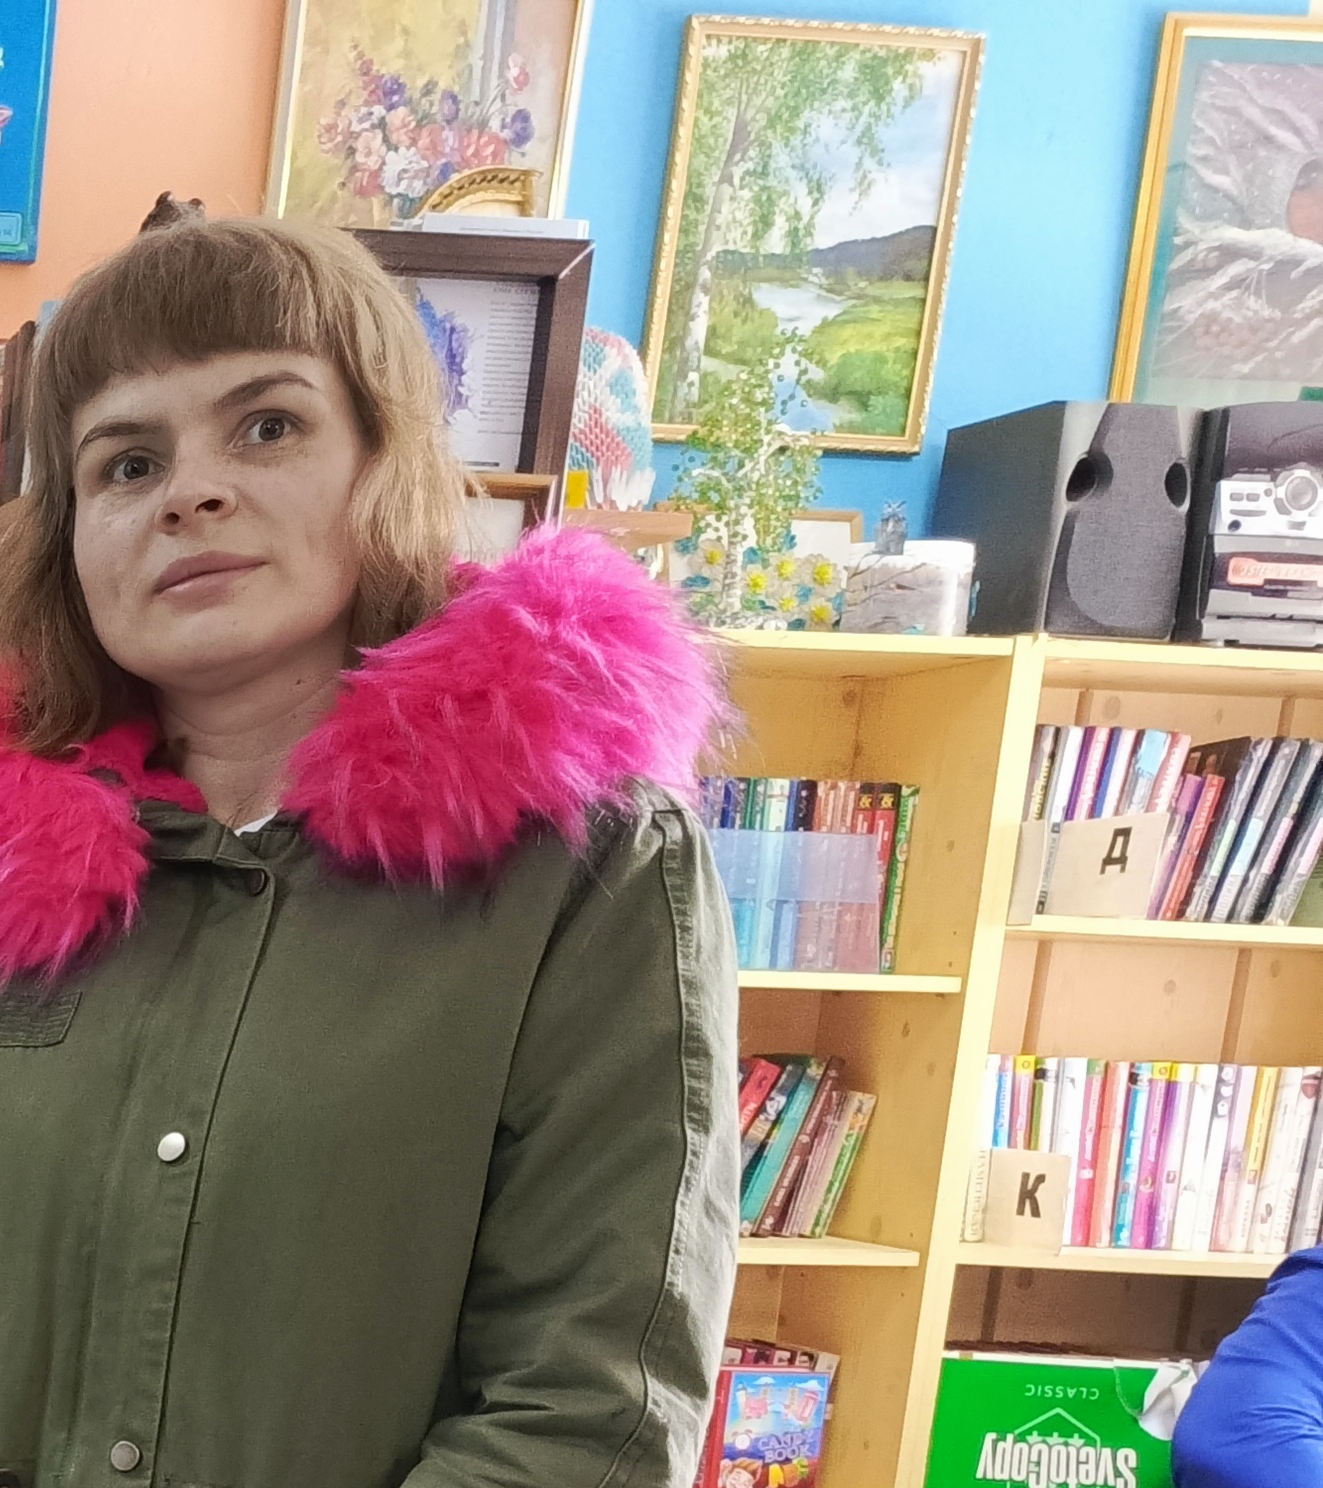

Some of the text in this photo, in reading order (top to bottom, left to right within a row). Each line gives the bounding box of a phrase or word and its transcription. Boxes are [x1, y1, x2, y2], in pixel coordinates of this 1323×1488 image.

[1099, 826, 1133, 875] Д
[1016, 1171, 1047, 1218] К
[1024, 1384, 1100, 1401] CLASSIC
[758, 1430, 816, 1452] CANDY
[763, 1442, 812, 1464] BOOK
